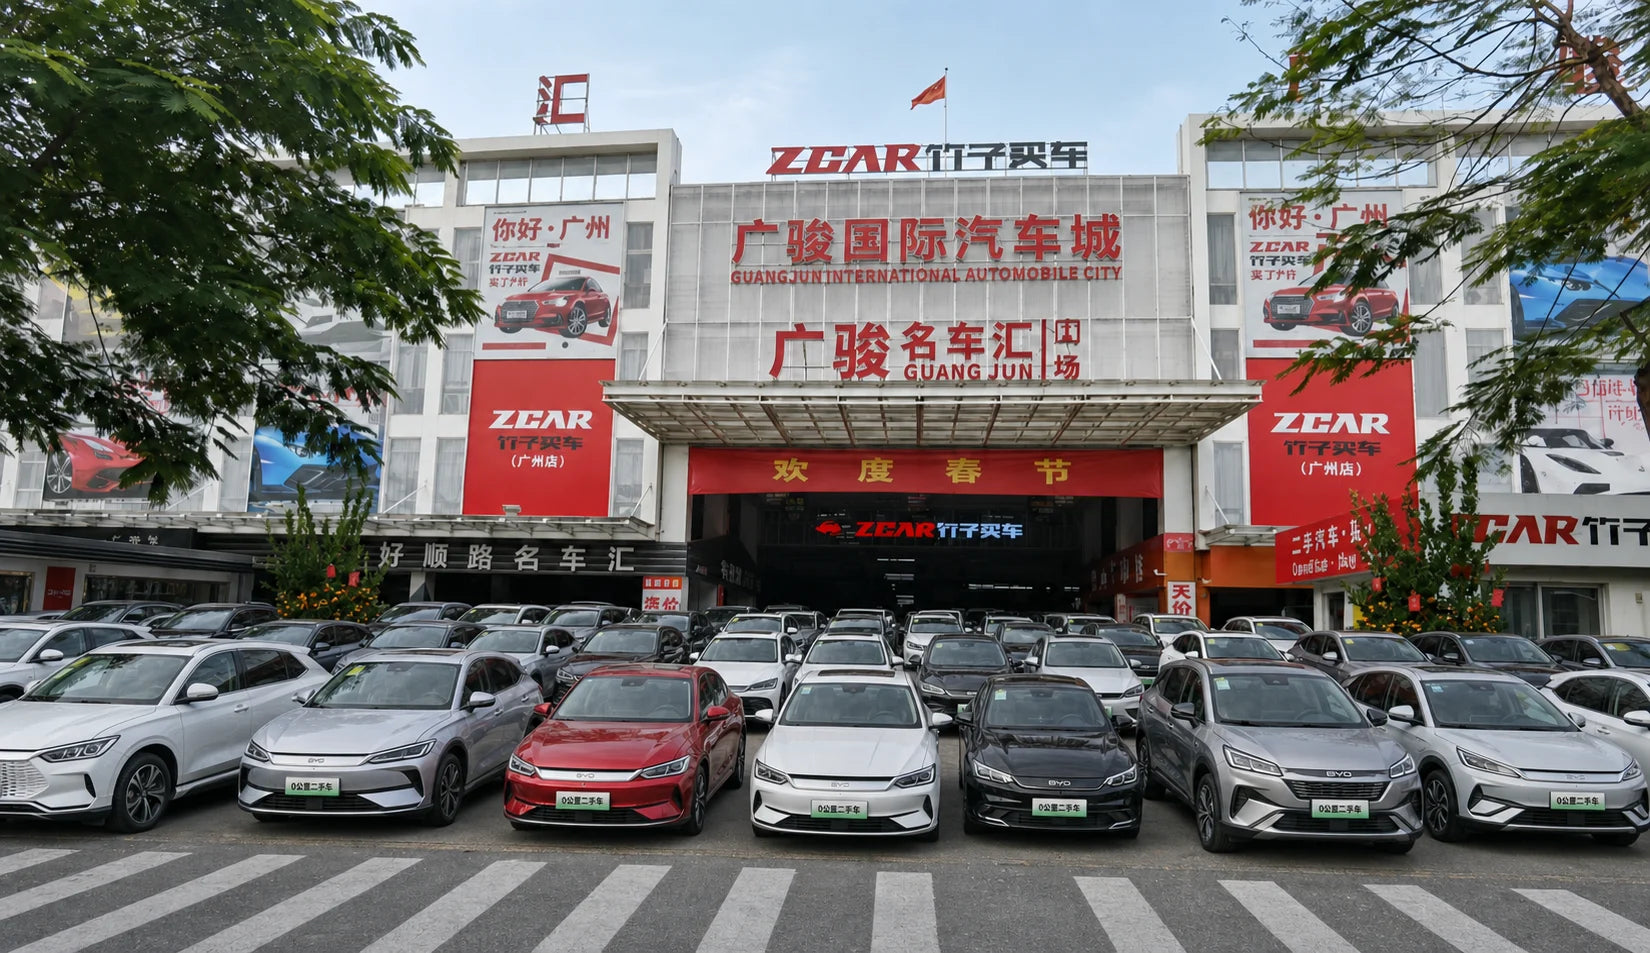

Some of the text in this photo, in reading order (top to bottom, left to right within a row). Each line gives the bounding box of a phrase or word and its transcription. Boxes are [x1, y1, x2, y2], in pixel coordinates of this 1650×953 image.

[534, 74, 588, 124] 汇
[766, 141, 1088, 174] ZCAR 竹子买车
[492, 215, 611, 242] 你好·广州
[1249, 203, 1388, 231] 你好·广州
[732, 214, 1121, 262] 广骏国际汽车城
[1249, 241, 1309, 252] ZCAR
[489, 251, 540, 262] ZCAR
[965, 267, 1079, 282] AUTOMOBILE
[1083, 265, 1122, 280] CITY
[904, 363, 1033, 380] GUANG JUN
[488, 409, 593, 430] ZCAR
[1270, 412, 1391, 435] ZCAR
[497, 435, 583, 451] 竹子买车
[1283, 440, 1382, 457] 竹子买车
[772, 457, 1072, 486] 欢度春节
[378, 541, 635, 572] 好顺路名车汇
